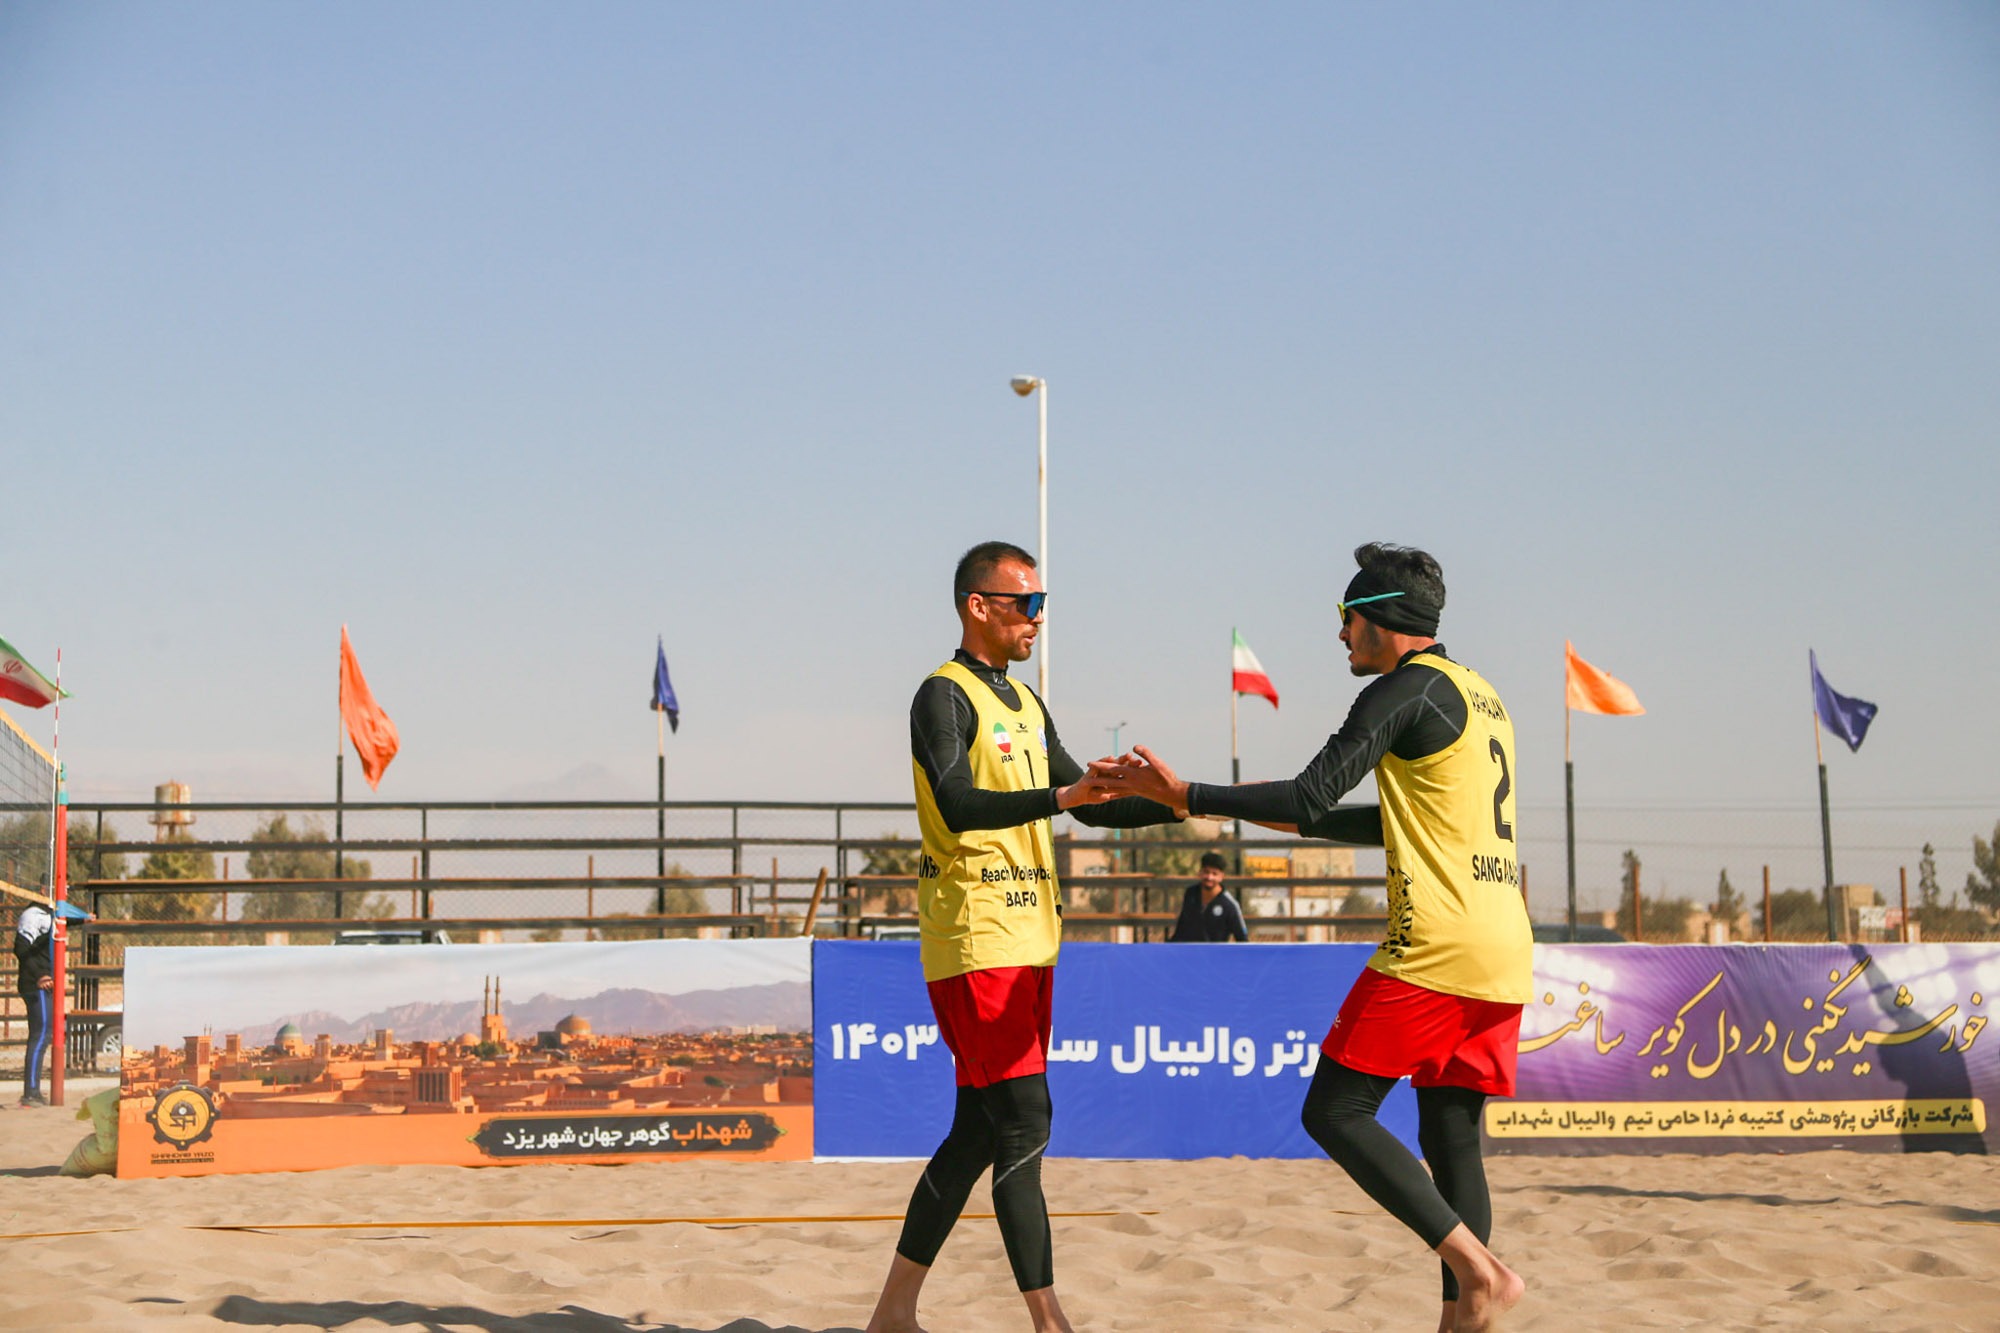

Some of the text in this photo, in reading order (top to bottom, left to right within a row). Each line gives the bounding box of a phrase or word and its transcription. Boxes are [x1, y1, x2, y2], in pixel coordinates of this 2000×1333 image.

[1488, 735, 1514, 843] 2
[981, 864, 1010, 883] Beach
[1472, 854, 1503, 883] SANG
[1005, 891, 1037, 907] BAFQ
[1518, 955, 1988, 1079] خورشید نگینی در دل کویر ساغن
[831, 1022, 939, 1061] ۱۴۰۳
[1111, 1025, 1256, 1077] والیبال
[1264, 1030, 1319, 1077] رتر
[502, 1119, 753, 1150] شهداب گوهر جهان شهر یزد
[1497, 1104, 1974, 1132] شرکت بازرگانی پژوهشی کتیبه فردا حامی تیم والیبال شهداب
